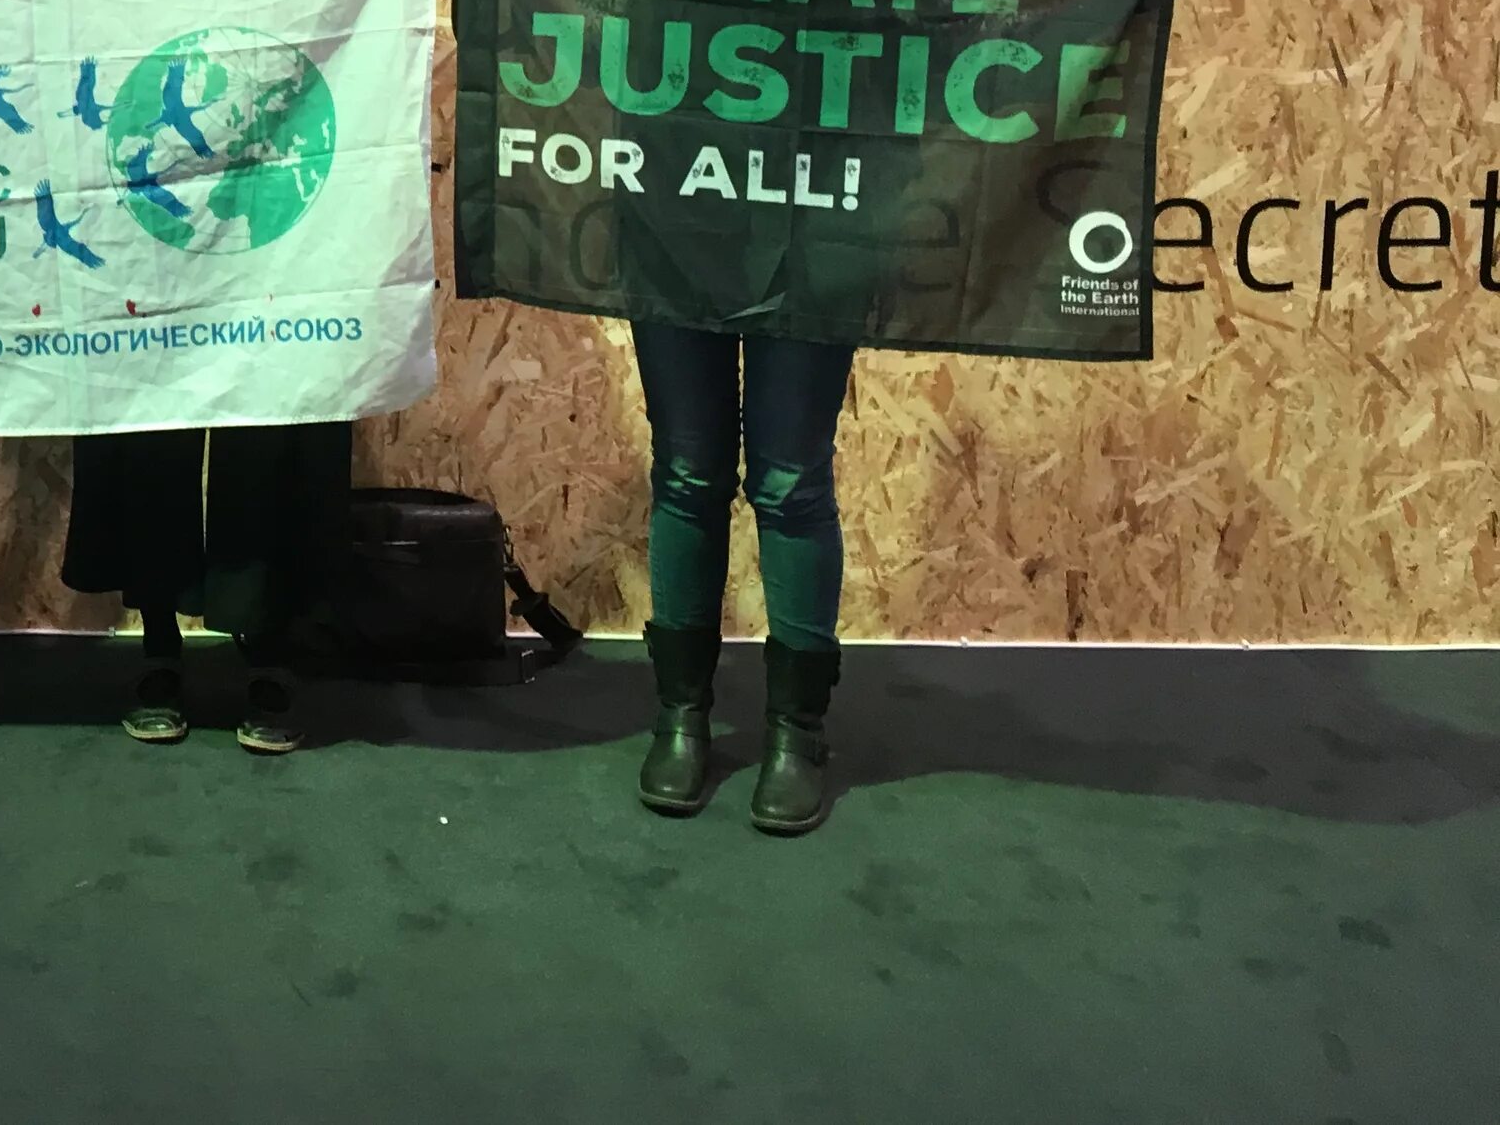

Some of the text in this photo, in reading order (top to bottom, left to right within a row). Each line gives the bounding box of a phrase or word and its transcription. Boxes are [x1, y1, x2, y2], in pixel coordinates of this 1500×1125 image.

[499, 11, 1131, 144] JUSTICE
[499, 127, 863, 212] FOR ALL!
[1062, 275, 1139, 291] Friends of
[1061, 290, 1139, 305] the Earth
[1060, 304, 1140, 316] International
[274, 316, 364, 344] СОЮЗ
